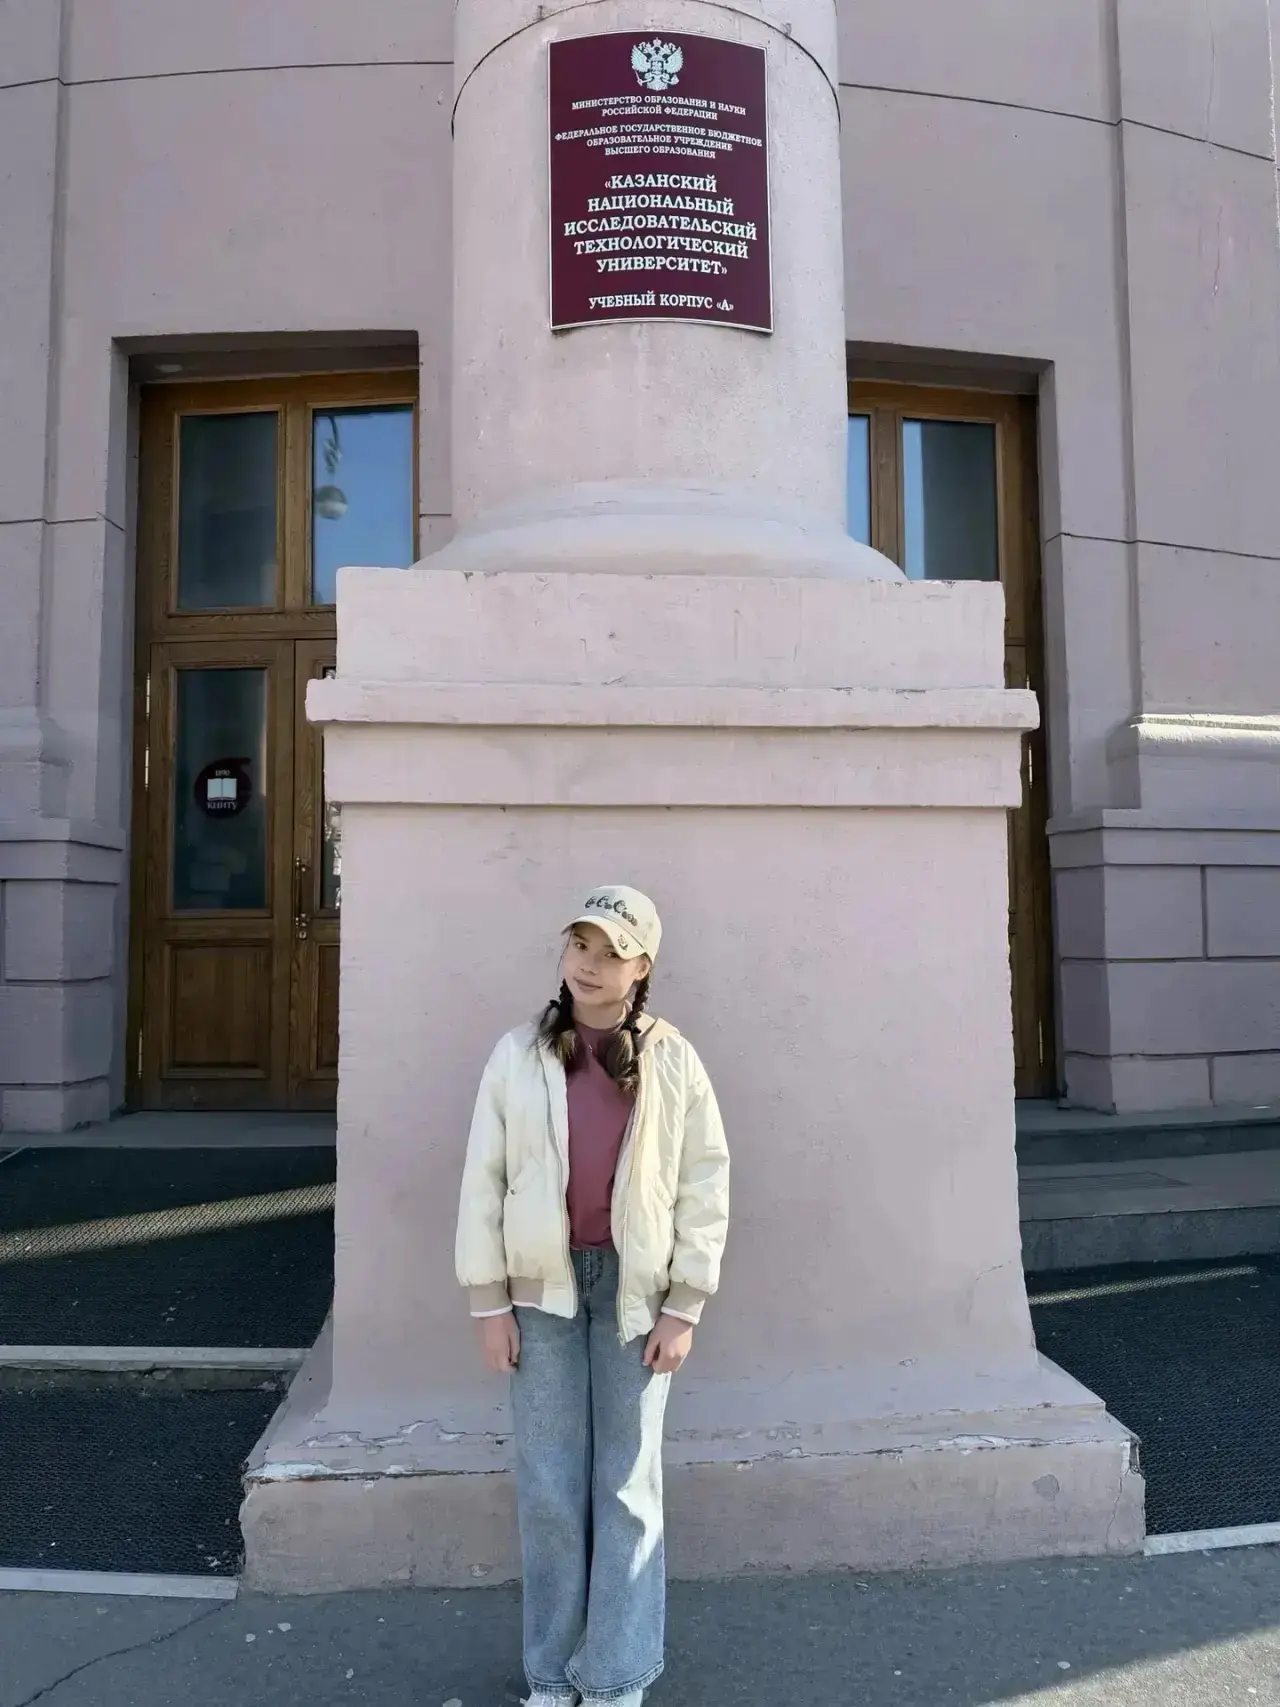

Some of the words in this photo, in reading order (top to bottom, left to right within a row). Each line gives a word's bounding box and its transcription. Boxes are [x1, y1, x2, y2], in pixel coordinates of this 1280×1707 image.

[572, 96, 642, 110] МИНИСТЕРСТВО
[644, 95, 707, 108] ОБРАЗОВАНИЯ
[709, 101, 716, 109] И
[718, 102, 746, 115] НАУКИ
[602, 105, 662, 116] РОССИЙСКОЙ
[664, 107, 718, 120] ФЕДЕРАЦИИ
[555, 125, 618, 141] ФЕДЕРАЛЬНОЕ
[620, 124, 706, 136] ГОСУДАРСТВЕННОЕ
[708, 129, 762, 147] БЮДЖЕТНОЕ
[586, 135, 672, 147] ОБРАЗОВАТЕЛЬНОЕ
[674, 136, 733, 151] УЧРЕЖДЕНИЕ
[605, 146, 650, 155] ВЫСШЕГО
[652, 146, 716, 159] ОБРАЗОВАНИЯ
[604, 174, 717, 192] «КАЗАНСКИЙ
[588, 195, 734, 216] НАЦИОНАЛЬНЫЙ
[564, 215, 757, 240] ИССЛЕДОВАТЕЛЬСКИЙ
[574, 235, 749, 259] ТЕХНОЛОГИЧЕСКИЙ
[596, 256, 728, 275] УНИВЕРСИТЕТ»
[589, 290, 656, 310] УЧЕБНЫЙ
[660, 293, 713, 308] КОРПУС
[716, 299, 734, 311] «А»
[207, 801, 237, 810] КНИТУ
